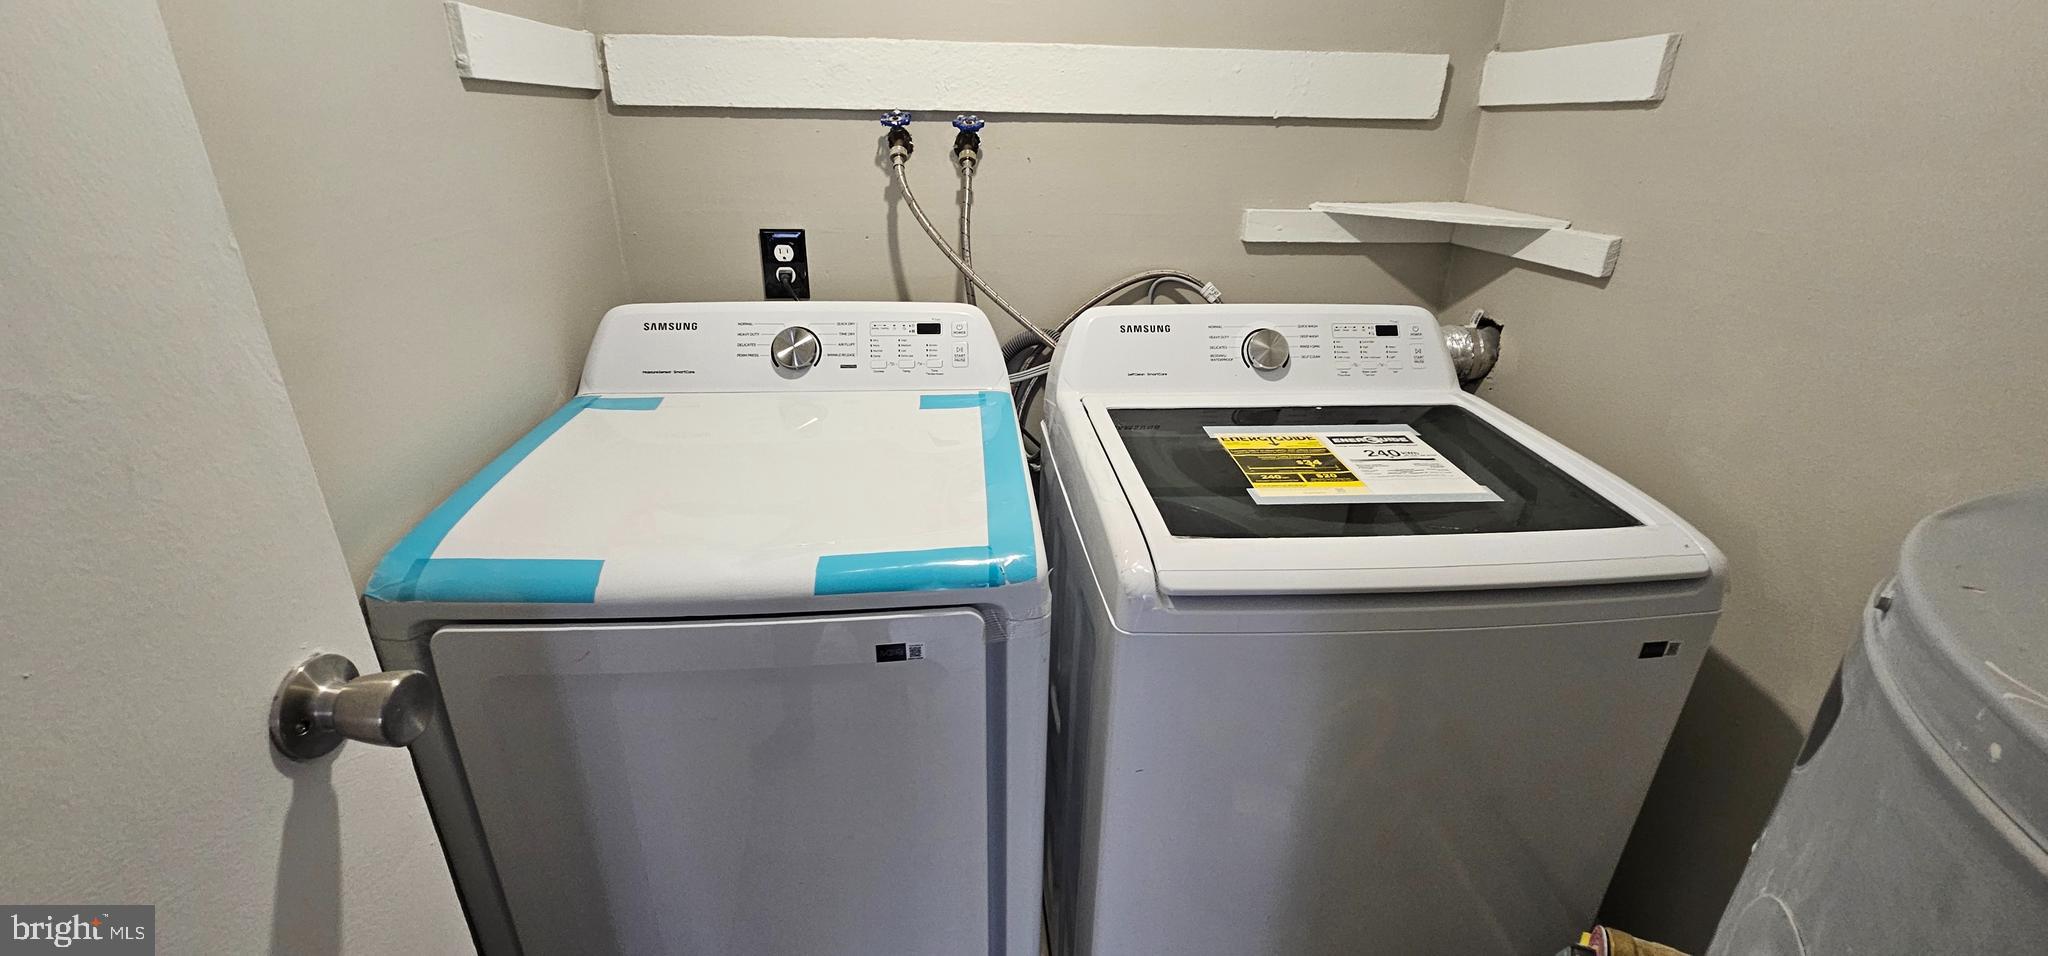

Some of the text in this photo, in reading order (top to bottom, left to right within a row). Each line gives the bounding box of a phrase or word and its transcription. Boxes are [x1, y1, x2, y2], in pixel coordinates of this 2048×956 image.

[643, 322, 698, 331] SAMSUNG
[1119, 324, 1171, 333] SAMSUNG
[1363, 449, 1401, 458] 240
